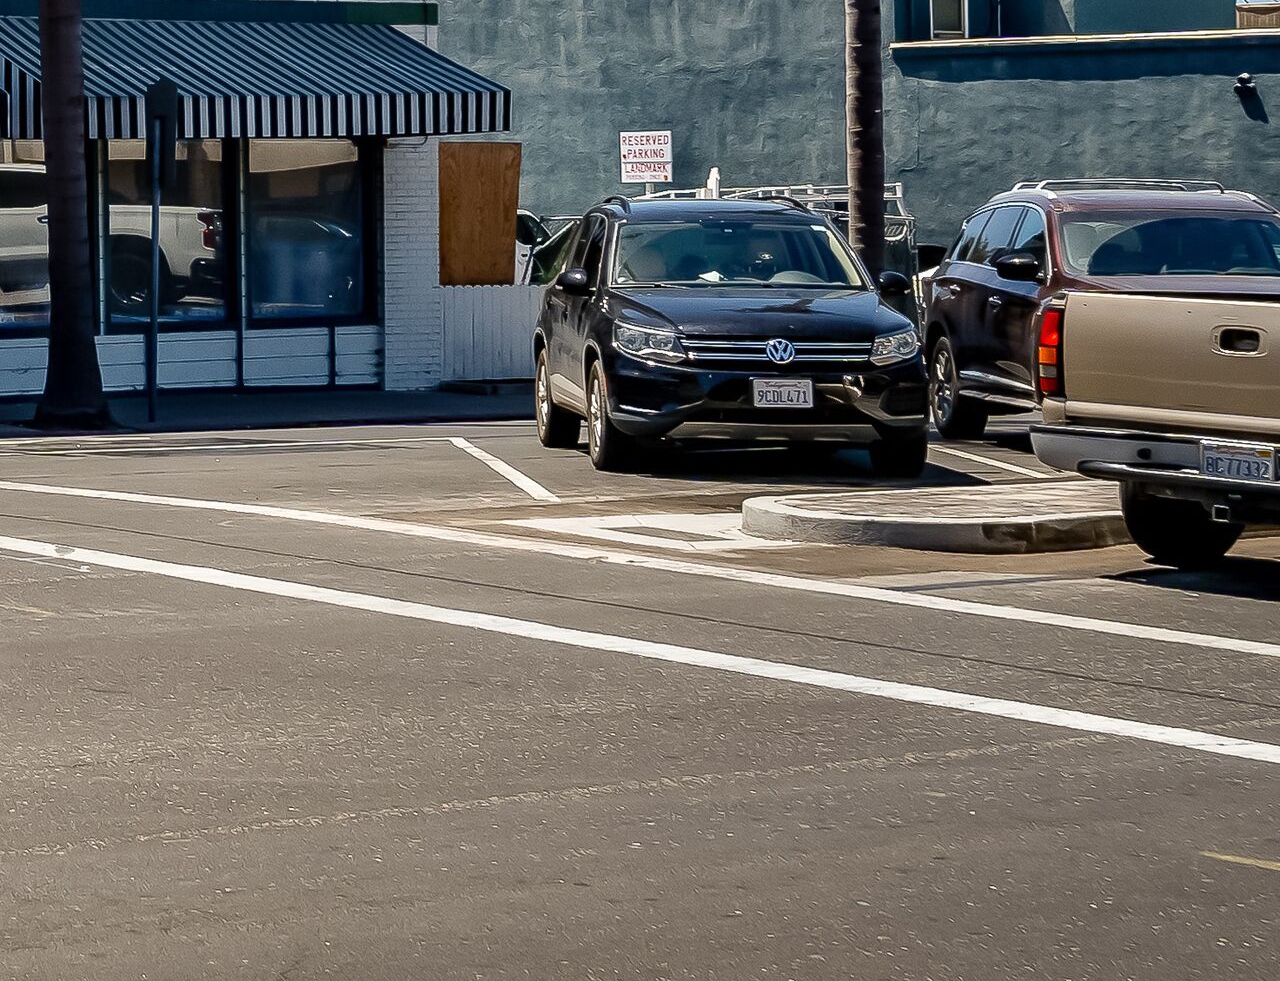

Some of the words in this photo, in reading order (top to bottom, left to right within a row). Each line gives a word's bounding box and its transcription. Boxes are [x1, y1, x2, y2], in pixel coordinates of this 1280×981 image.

[621, 135, 669, 146] RESERVED
[627, 149, 665, 159] PARKING
[625, 163, 668, 173] LANDMARK
[757, 389, 809, 404] 9CDL471
